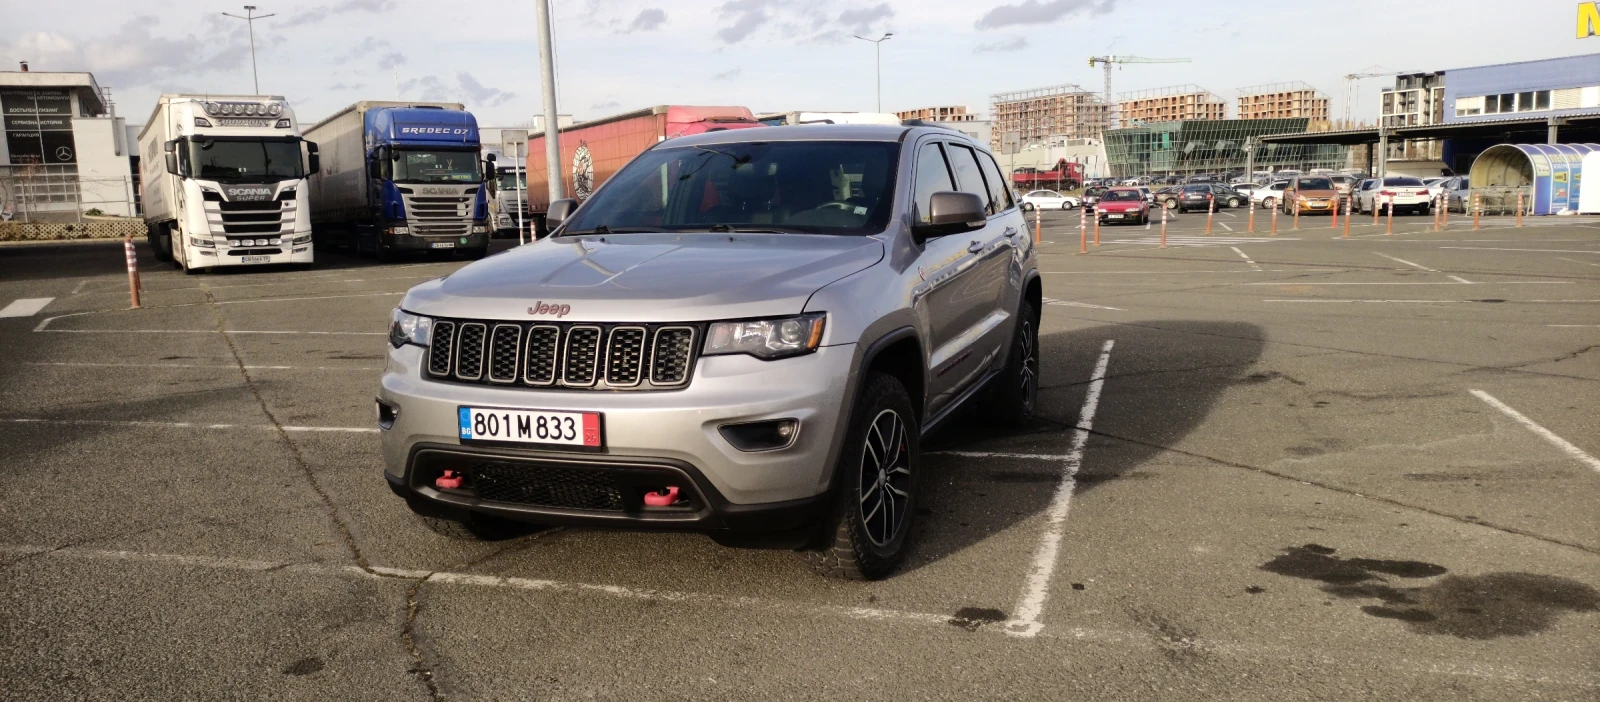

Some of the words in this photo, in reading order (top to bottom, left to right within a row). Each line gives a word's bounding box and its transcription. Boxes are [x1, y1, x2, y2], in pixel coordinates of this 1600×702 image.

[401, 127, 451, 135] SREDEC
[228, 188, 272, 196] SCANIA
[422, 187, 459, 195] SCANIA
[527, 300, 571, 319] Jeep
[461, 427, 471, 435] BG
